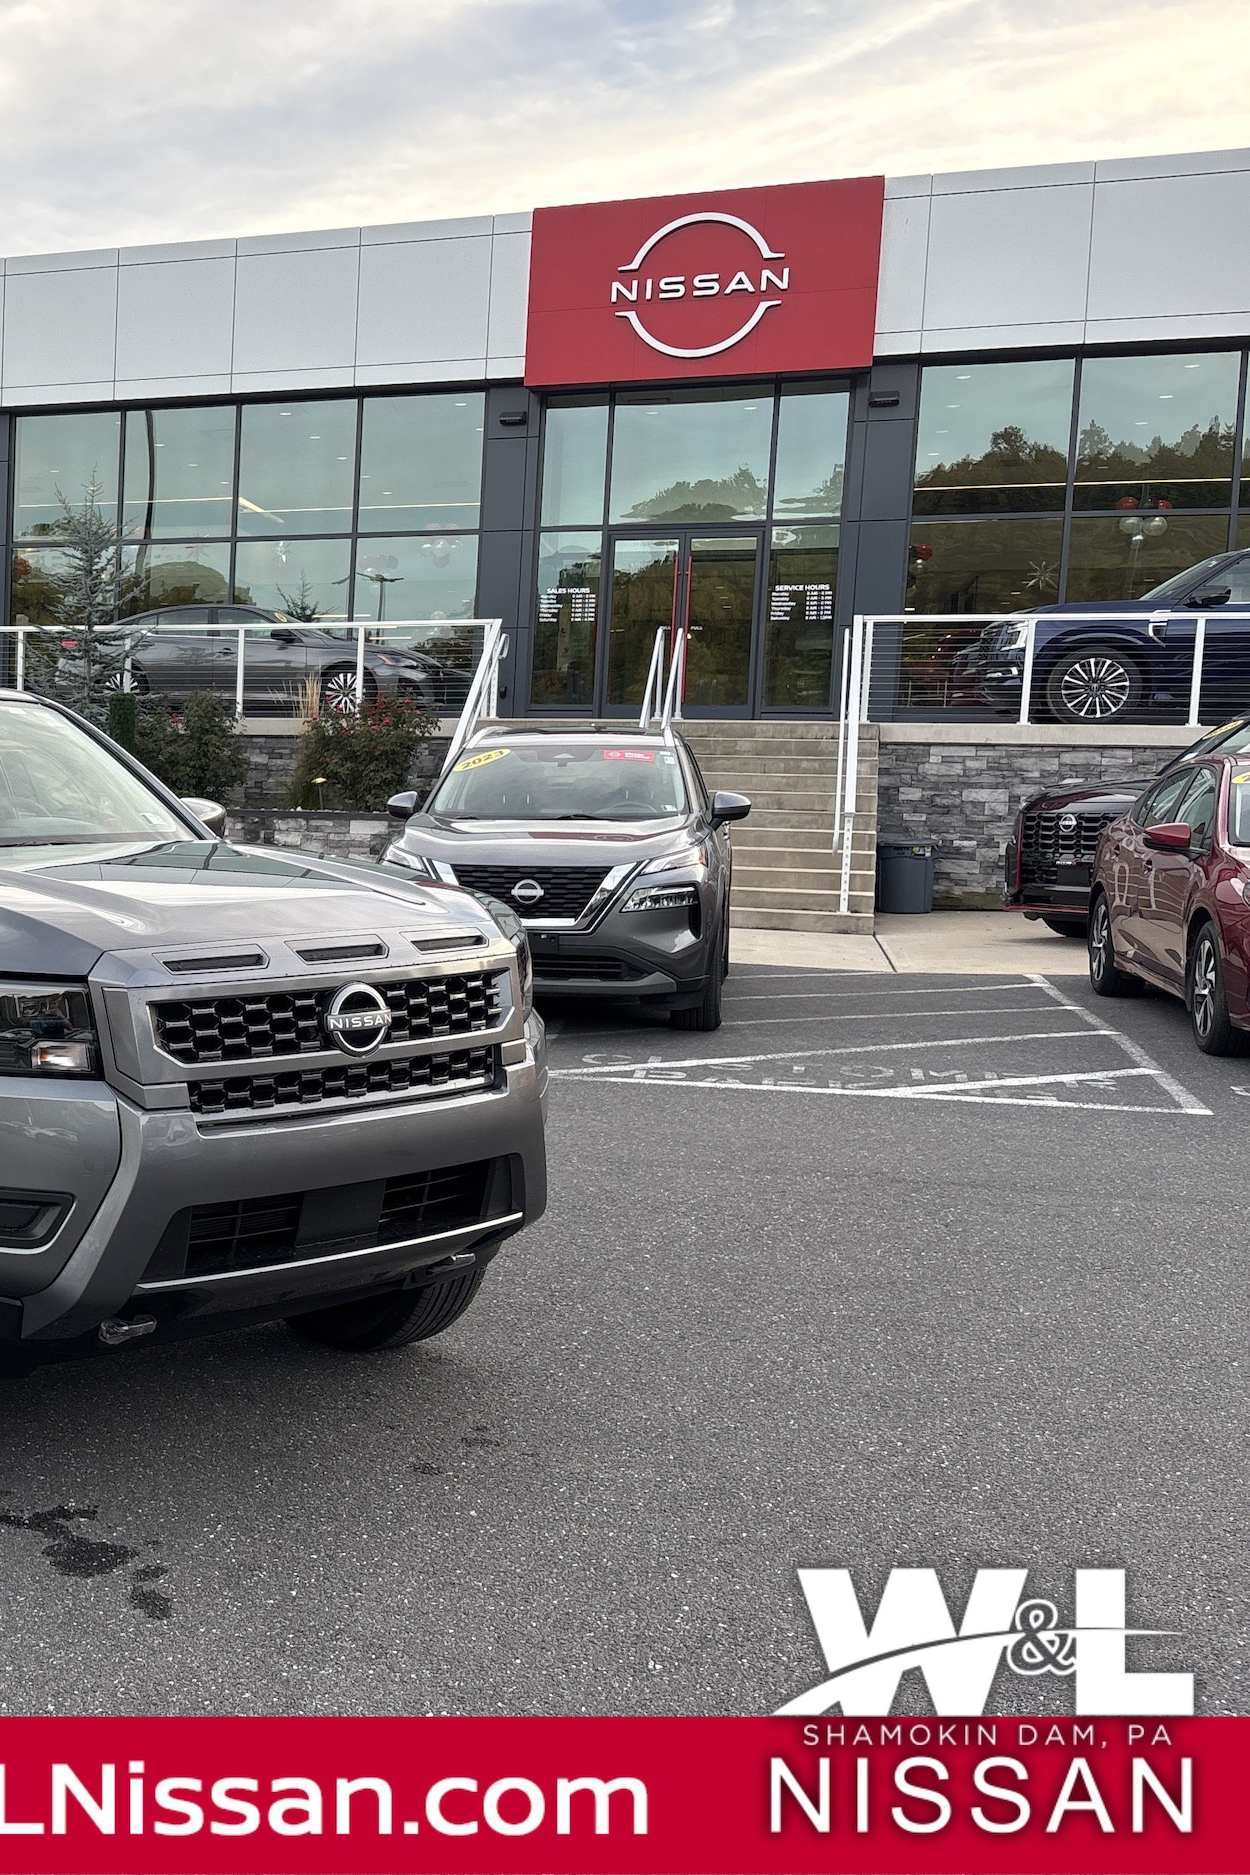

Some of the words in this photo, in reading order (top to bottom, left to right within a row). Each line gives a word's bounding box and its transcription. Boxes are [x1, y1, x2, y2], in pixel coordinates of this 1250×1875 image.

[611, 267, 790, 303] NISSAN
[461, 750, 505, 769] 2023
[330, 1014, 392, 1029] NISSAN
